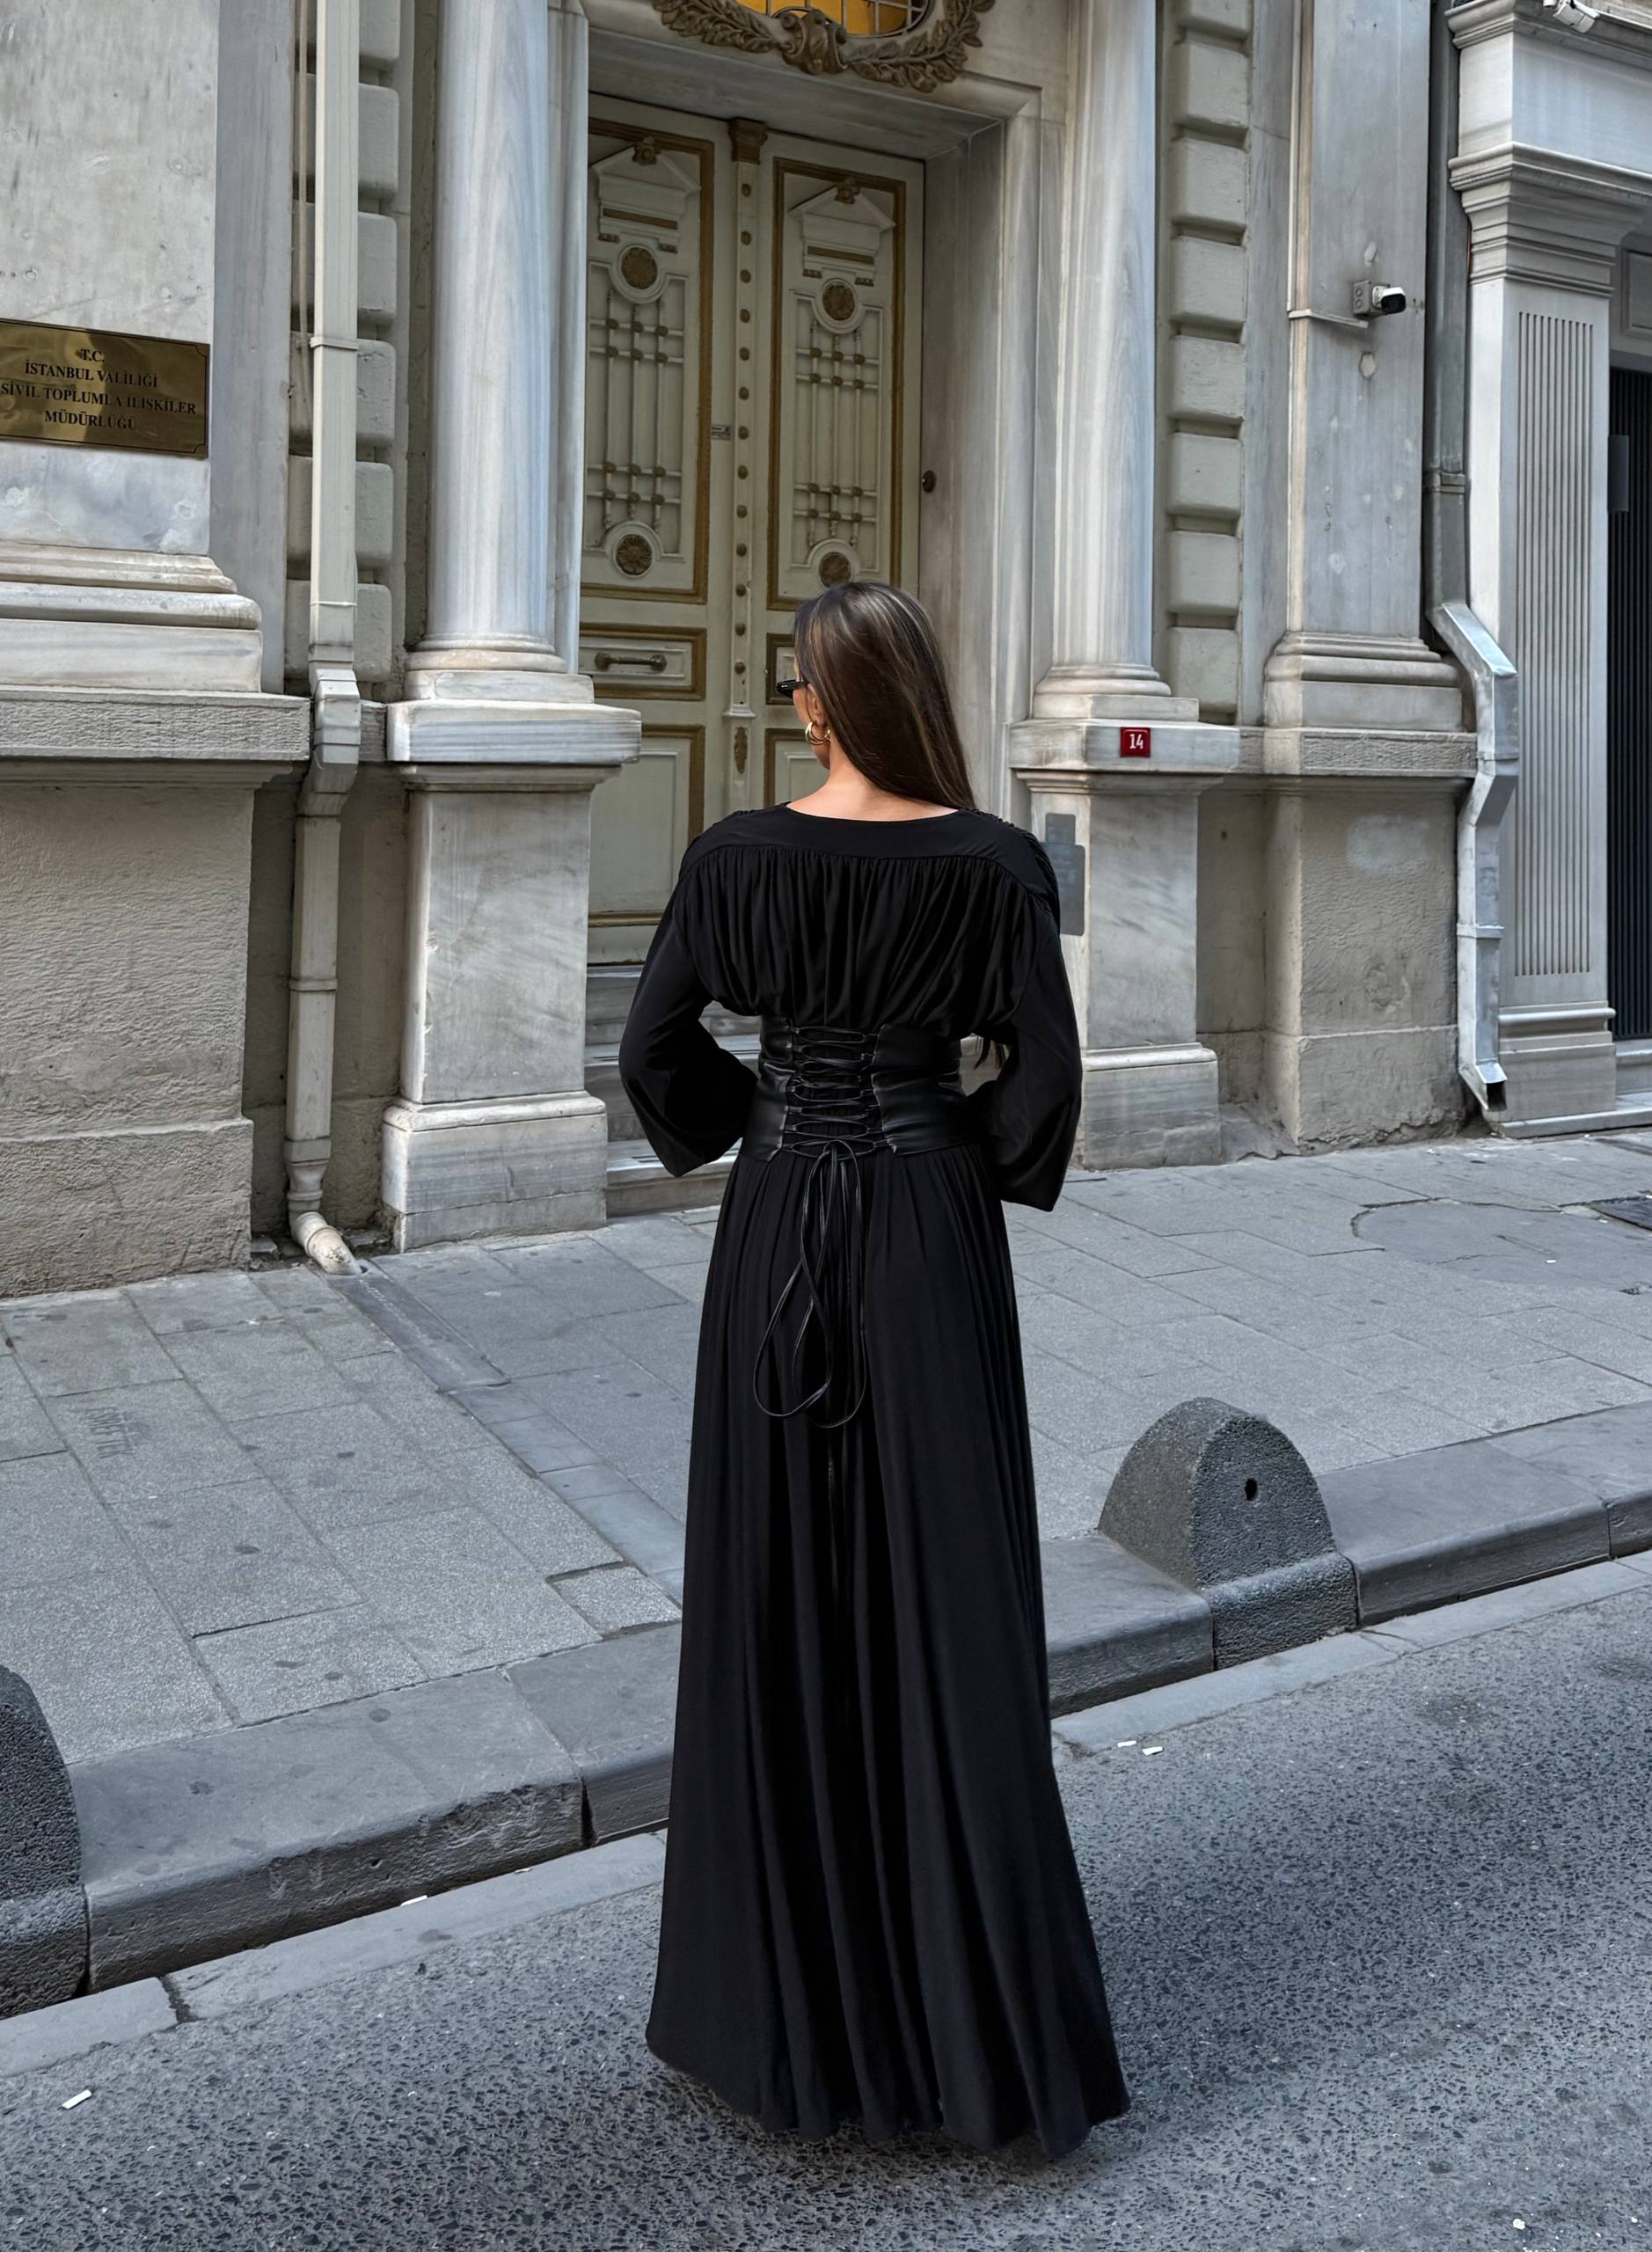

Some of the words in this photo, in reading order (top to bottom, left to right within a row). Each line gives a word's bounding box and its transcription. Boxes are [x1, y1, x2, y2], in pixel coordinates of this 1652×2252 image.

[80, 348, 105, 362] T.C.
[25, 359, 94, 381] İSTANBUL
[97, 369, 158, 388] VALİLİĞİ
[43, 387, 122, 407] TOPLUMLA
[1129, 733, 1144, 749] 14
